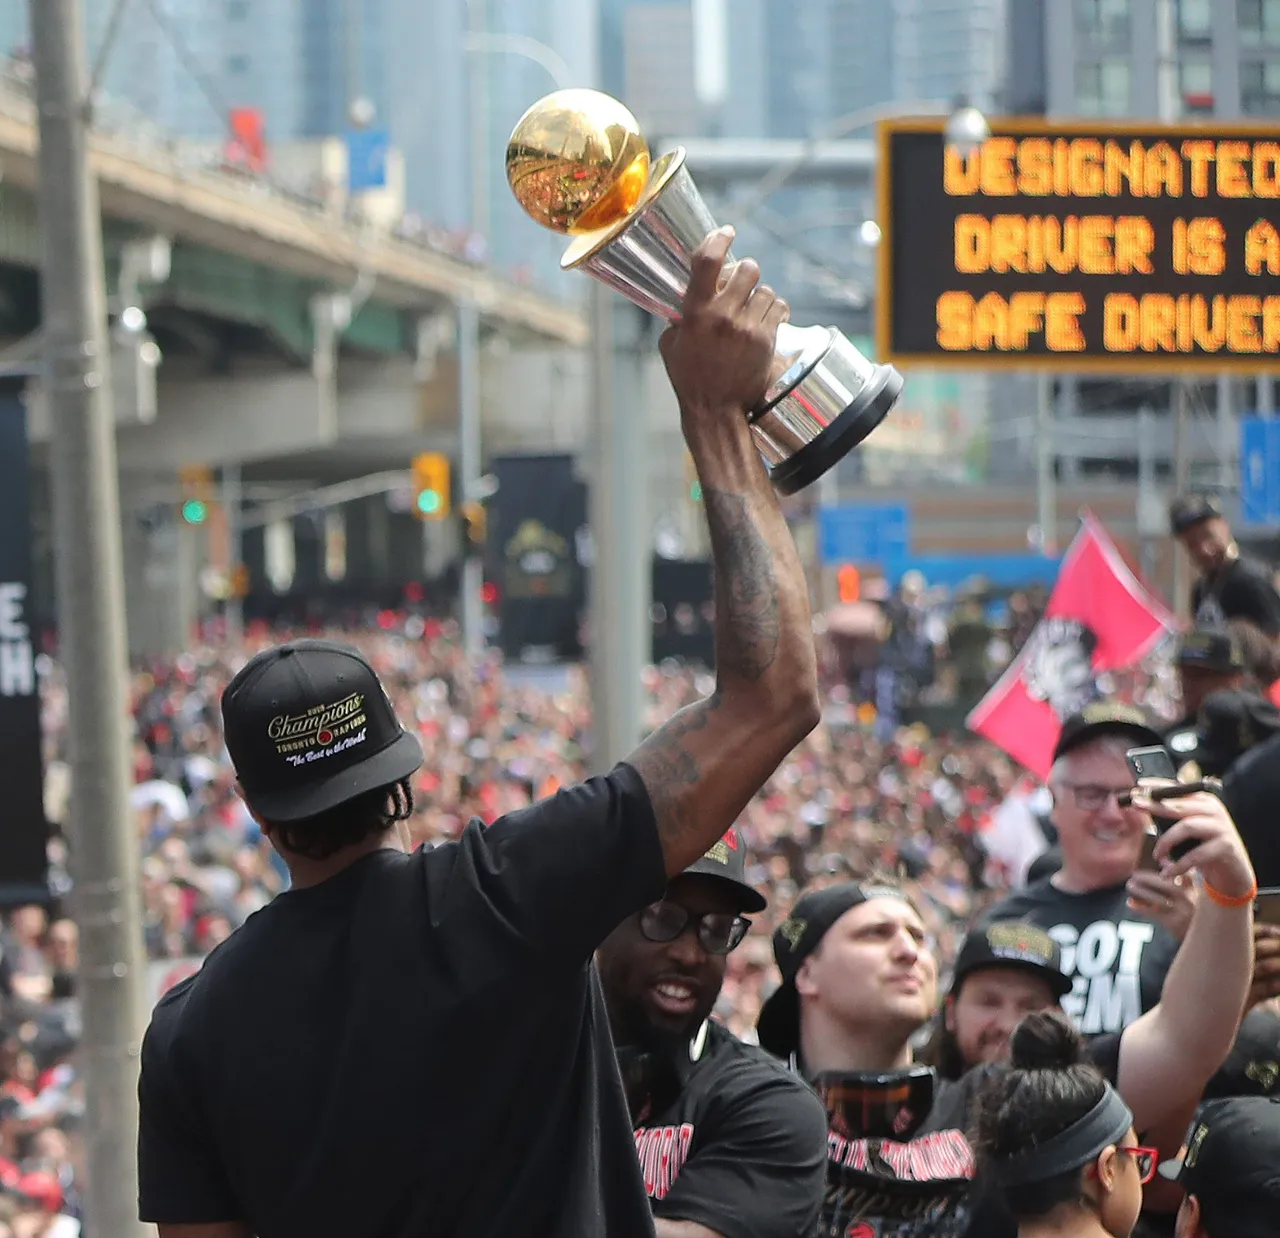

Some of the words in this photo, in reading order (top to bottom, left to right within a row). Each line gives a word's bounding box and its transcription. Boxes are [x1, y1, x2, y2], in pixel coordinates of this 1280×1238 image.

[943, 136, 1280, 198] DESIGNATED
[954, 213, 1155, 275] DRIVER
[1172, 216, 1227, 276] IS
[1244, 217, 1280, 277] A
[936, 290, 1087, 352] SAFE
[267, 694, 364, 742] Champions
[276, 736, 316, 754] TORONTO
[333, 713, 367, 738] RAPTORS
